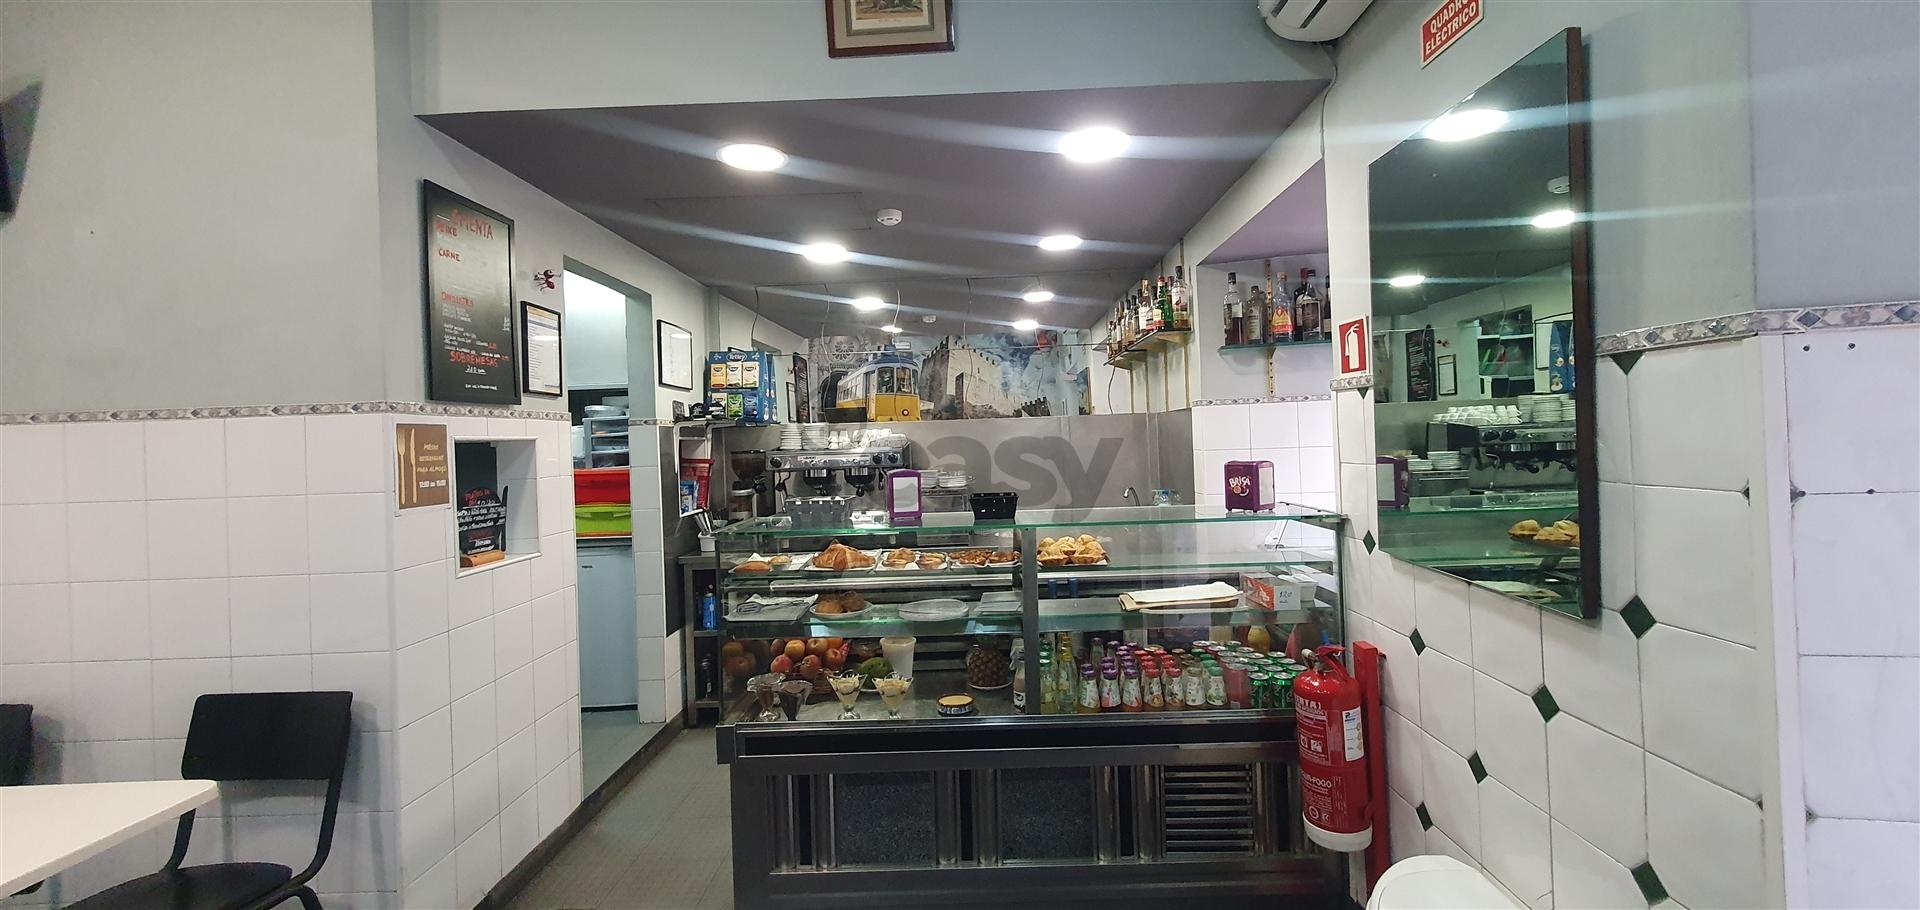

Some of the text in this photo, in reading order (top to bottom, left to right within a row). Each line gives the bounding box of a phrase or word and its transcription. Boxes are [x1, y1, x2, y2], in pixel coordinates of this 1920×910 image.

[1425, 2, 1477, 55] ELECTRICO
[438, 247, 461, 262] CARNE
[449, 350, 499, 368] SOBREMESAS
